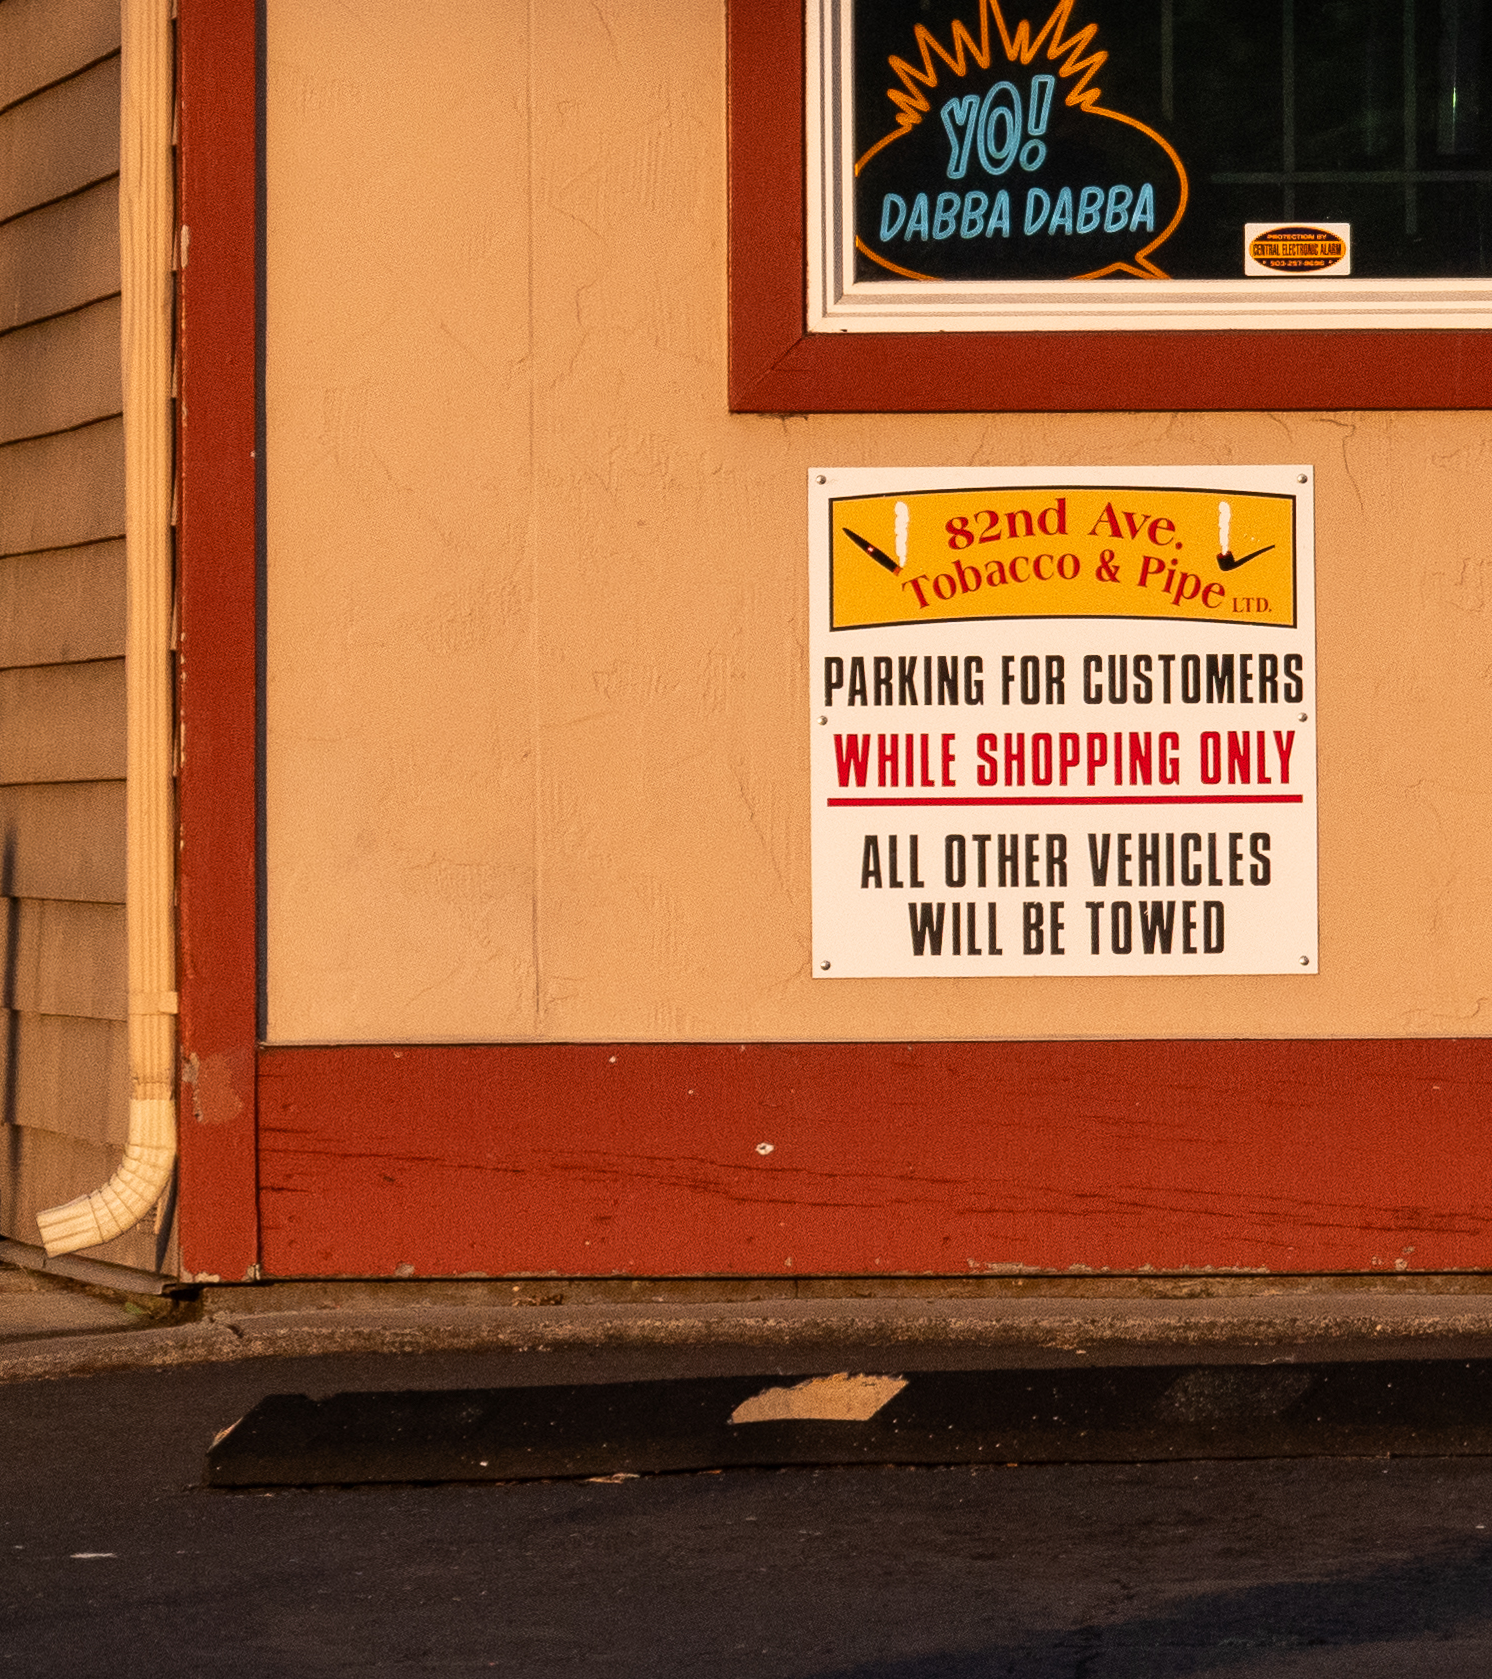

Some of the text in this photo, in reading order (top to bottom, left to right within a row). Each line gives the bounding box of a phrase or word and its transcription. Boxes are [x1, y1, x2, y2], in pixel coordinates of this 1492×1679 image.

[940, 74, 1056, 180] YO!
[879, 182, 1155, 242] DABBA DABBA
[1253, 243, 1342, 256] CENTRAL ELECTRONIC ALARM
[945, 497, 1183, 551] 82nd Ave.
[901, 549, 1273, 614] Tobacco & Pipe LTD.
[824, 653, 1304, 707] PARKING FOR CUSTOMERS
[833, 730, 1296, 787] WHILE SHOPPING ONLY
[860, 832, 1272, 889] ALL OTHER VEHICLES
[908, 900, 1226, 956] WILL BE TOWED
